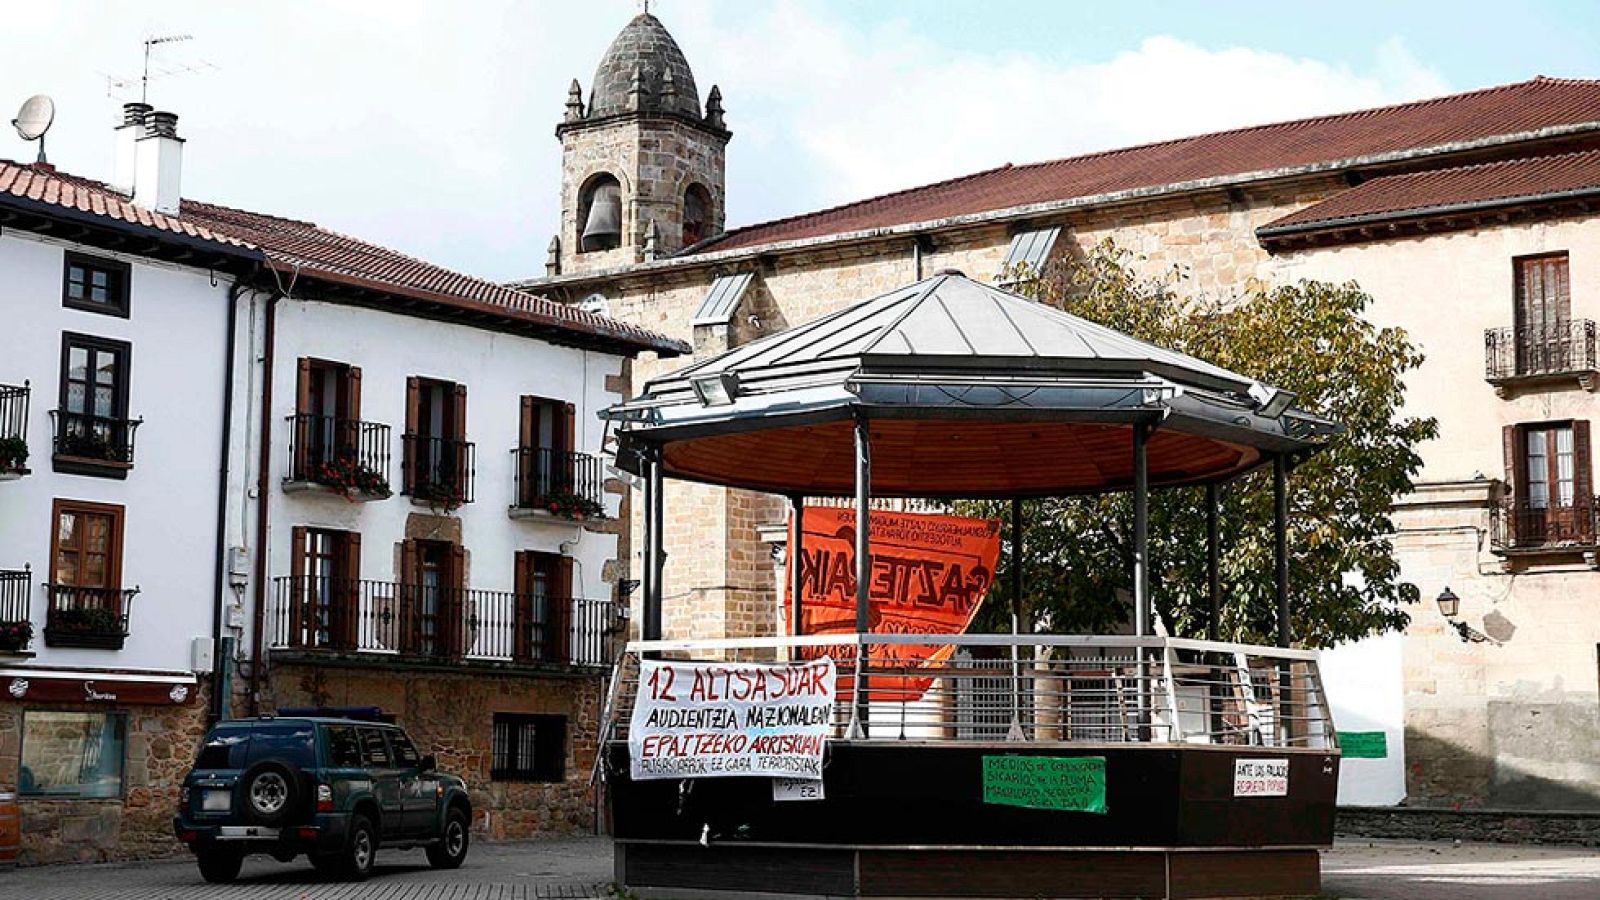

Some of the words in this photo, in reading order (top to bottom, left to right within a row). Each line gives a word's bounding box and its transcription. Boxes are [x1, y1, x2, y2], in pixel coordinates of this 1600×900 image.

[647, 666, 677, 701] 12
[691, 664, 829, 702] ALTSASUAR
[645, 707, 739, 730] AUDIENTZIA
[642, 734, 748, 757] EPAITZEKO
[711, 758, 725, 771] EZ
[725, 757, 751, 772] GARA
[755, 756, 822, 776] TERRORISTAK
[1237, 764, 1253, 776] ANTE
[1061, 774, 1097, 786] PLUMA
